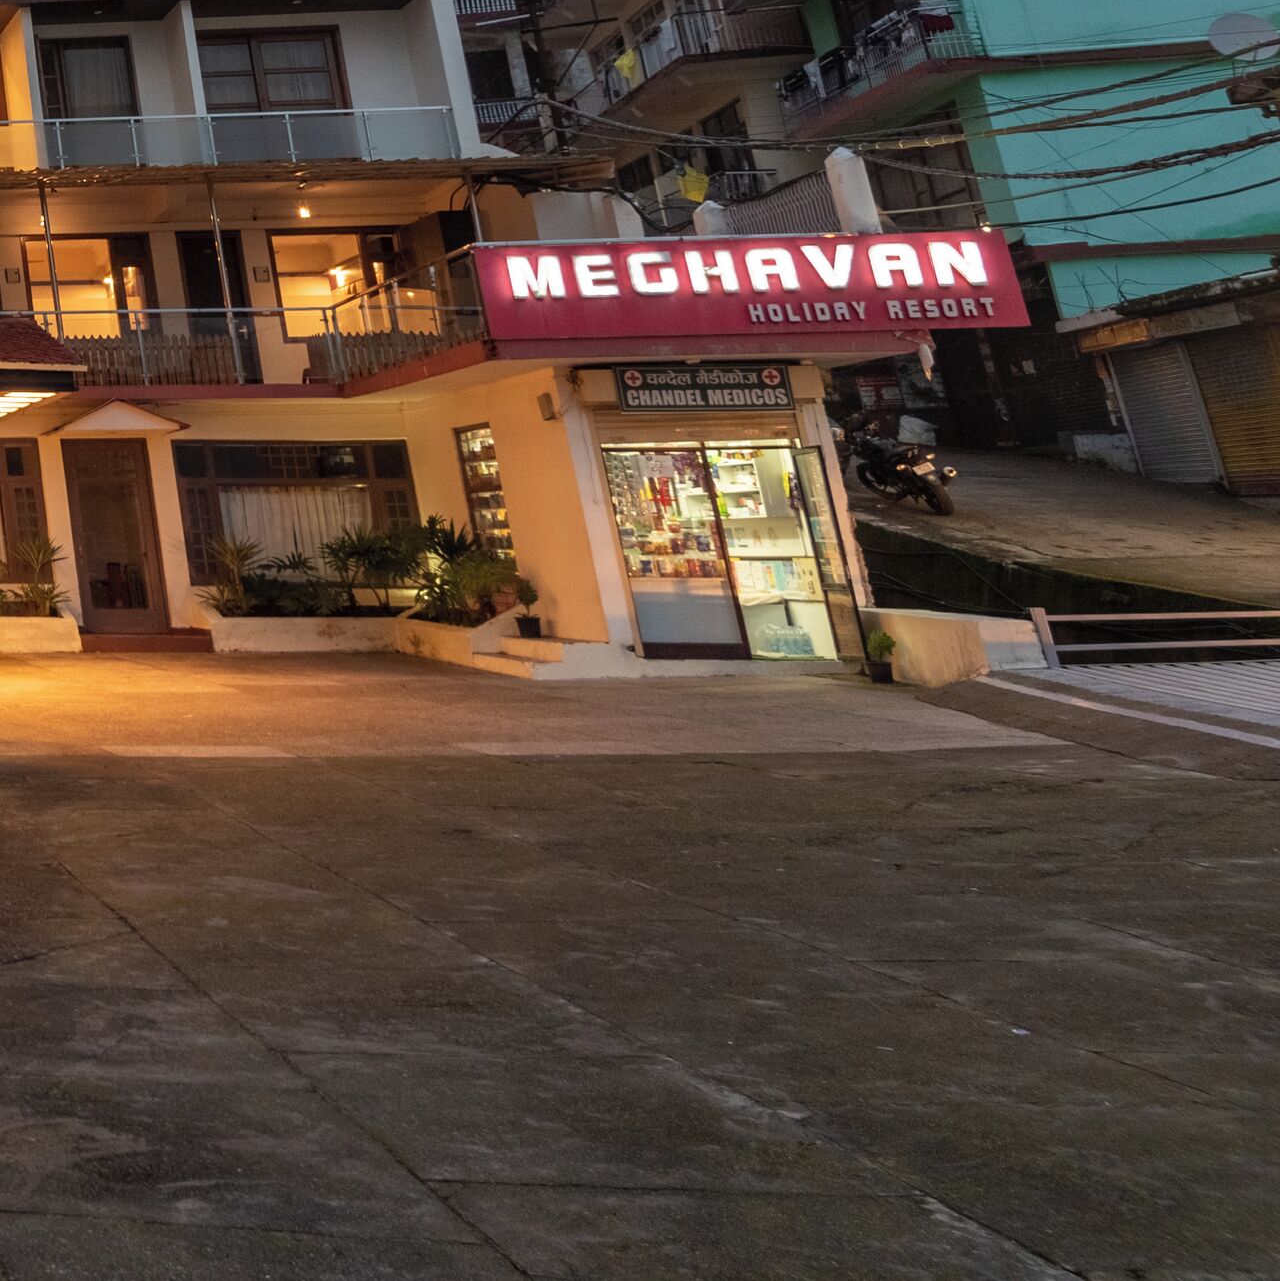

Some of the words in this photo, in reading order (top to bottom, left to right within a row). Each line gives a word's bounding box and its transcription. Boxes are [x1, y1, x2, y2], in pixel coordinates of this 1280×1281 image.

[506, 241, 989, 299] MEGHAVAN
[750, 301, 867, 324] HOLIDAY
[887, 297, 996, 320] RESORT
[627, 389, 706, 407] CHANDEL
[708, 388, 789, 406] MEDICOS
